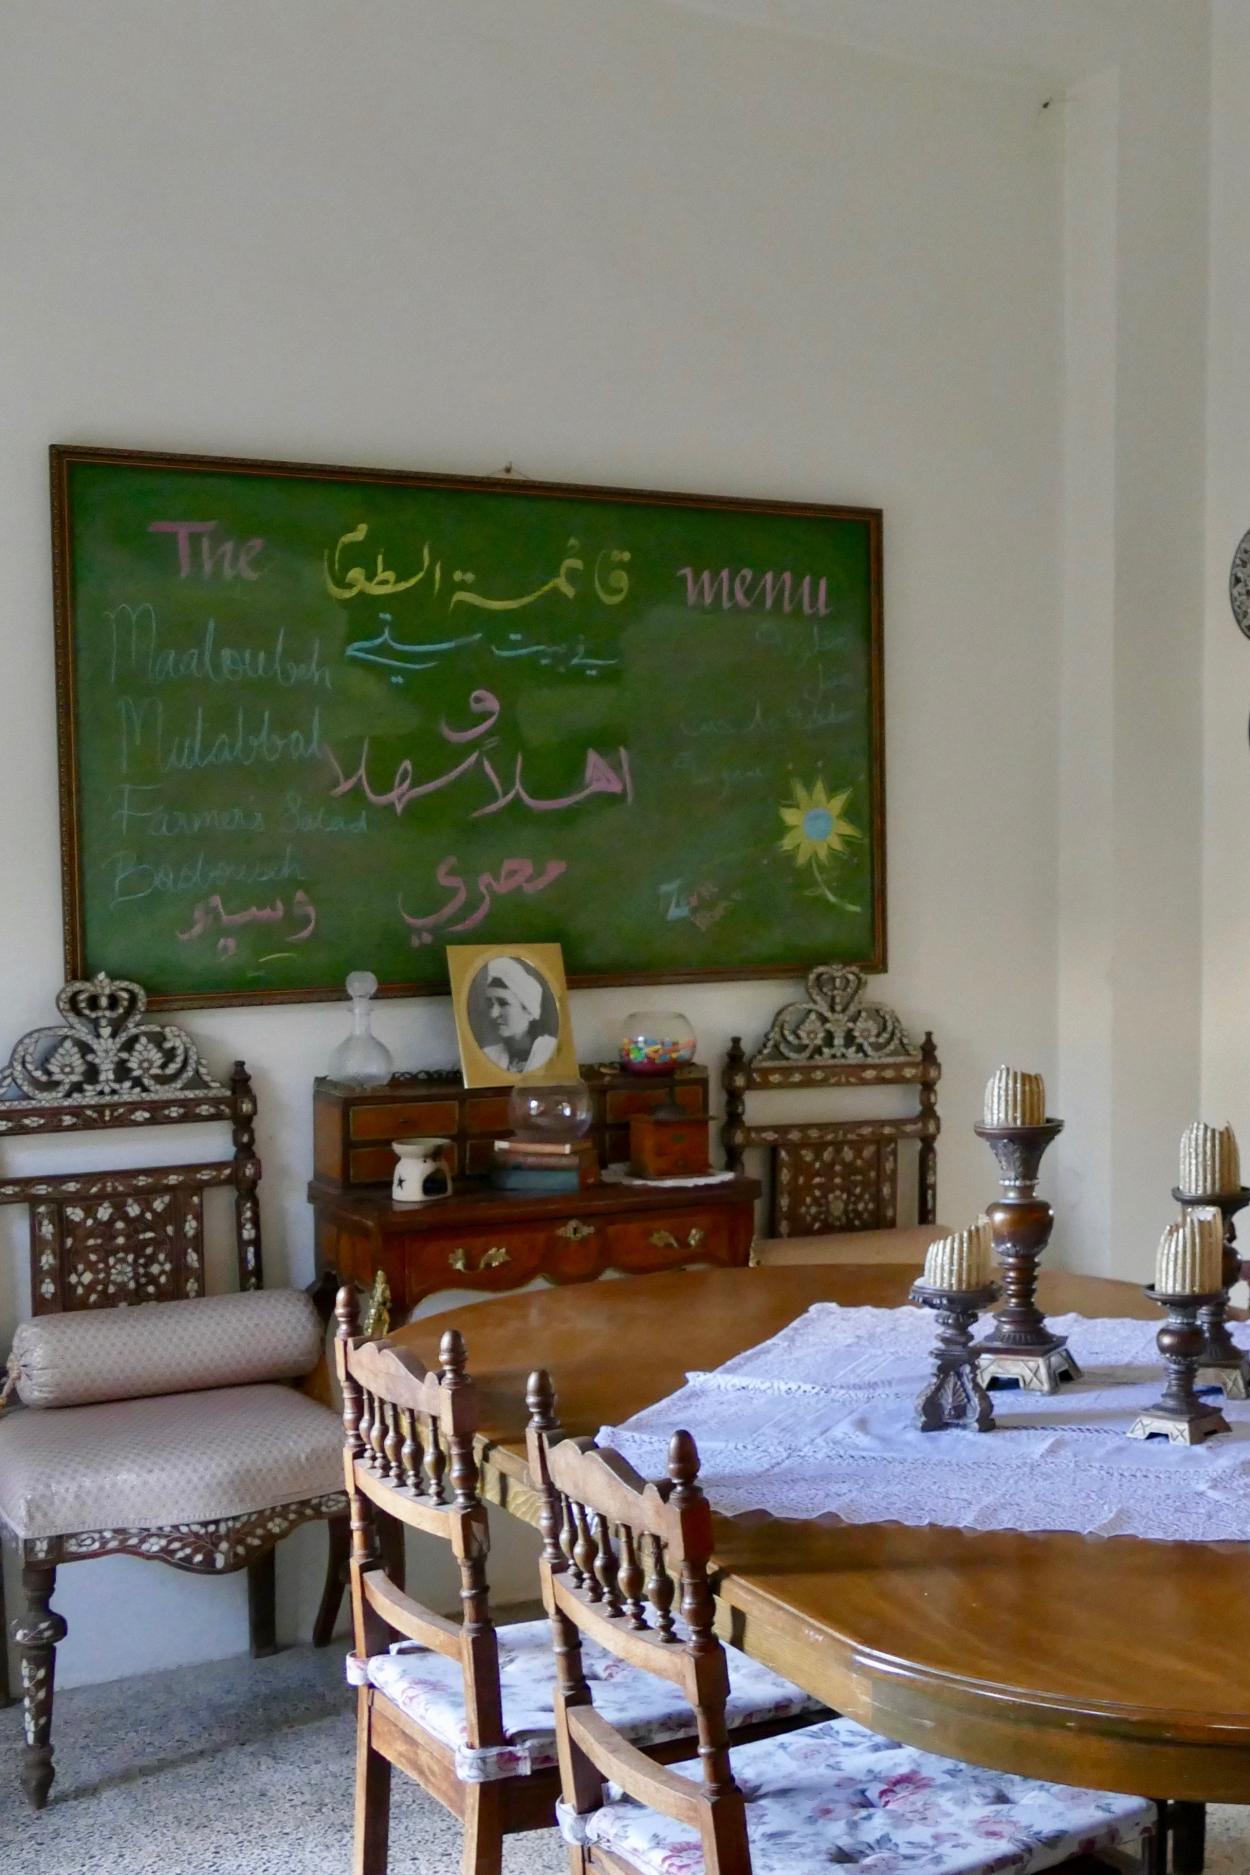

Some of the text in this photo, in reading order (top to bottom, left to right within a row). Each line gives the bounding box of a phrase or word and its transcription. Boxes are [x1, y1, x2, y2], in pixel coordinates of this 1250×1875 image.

[147, 520, 266, 580] The
[677, 566, 832, 617] menu
[441, 689, 500, 743] و
